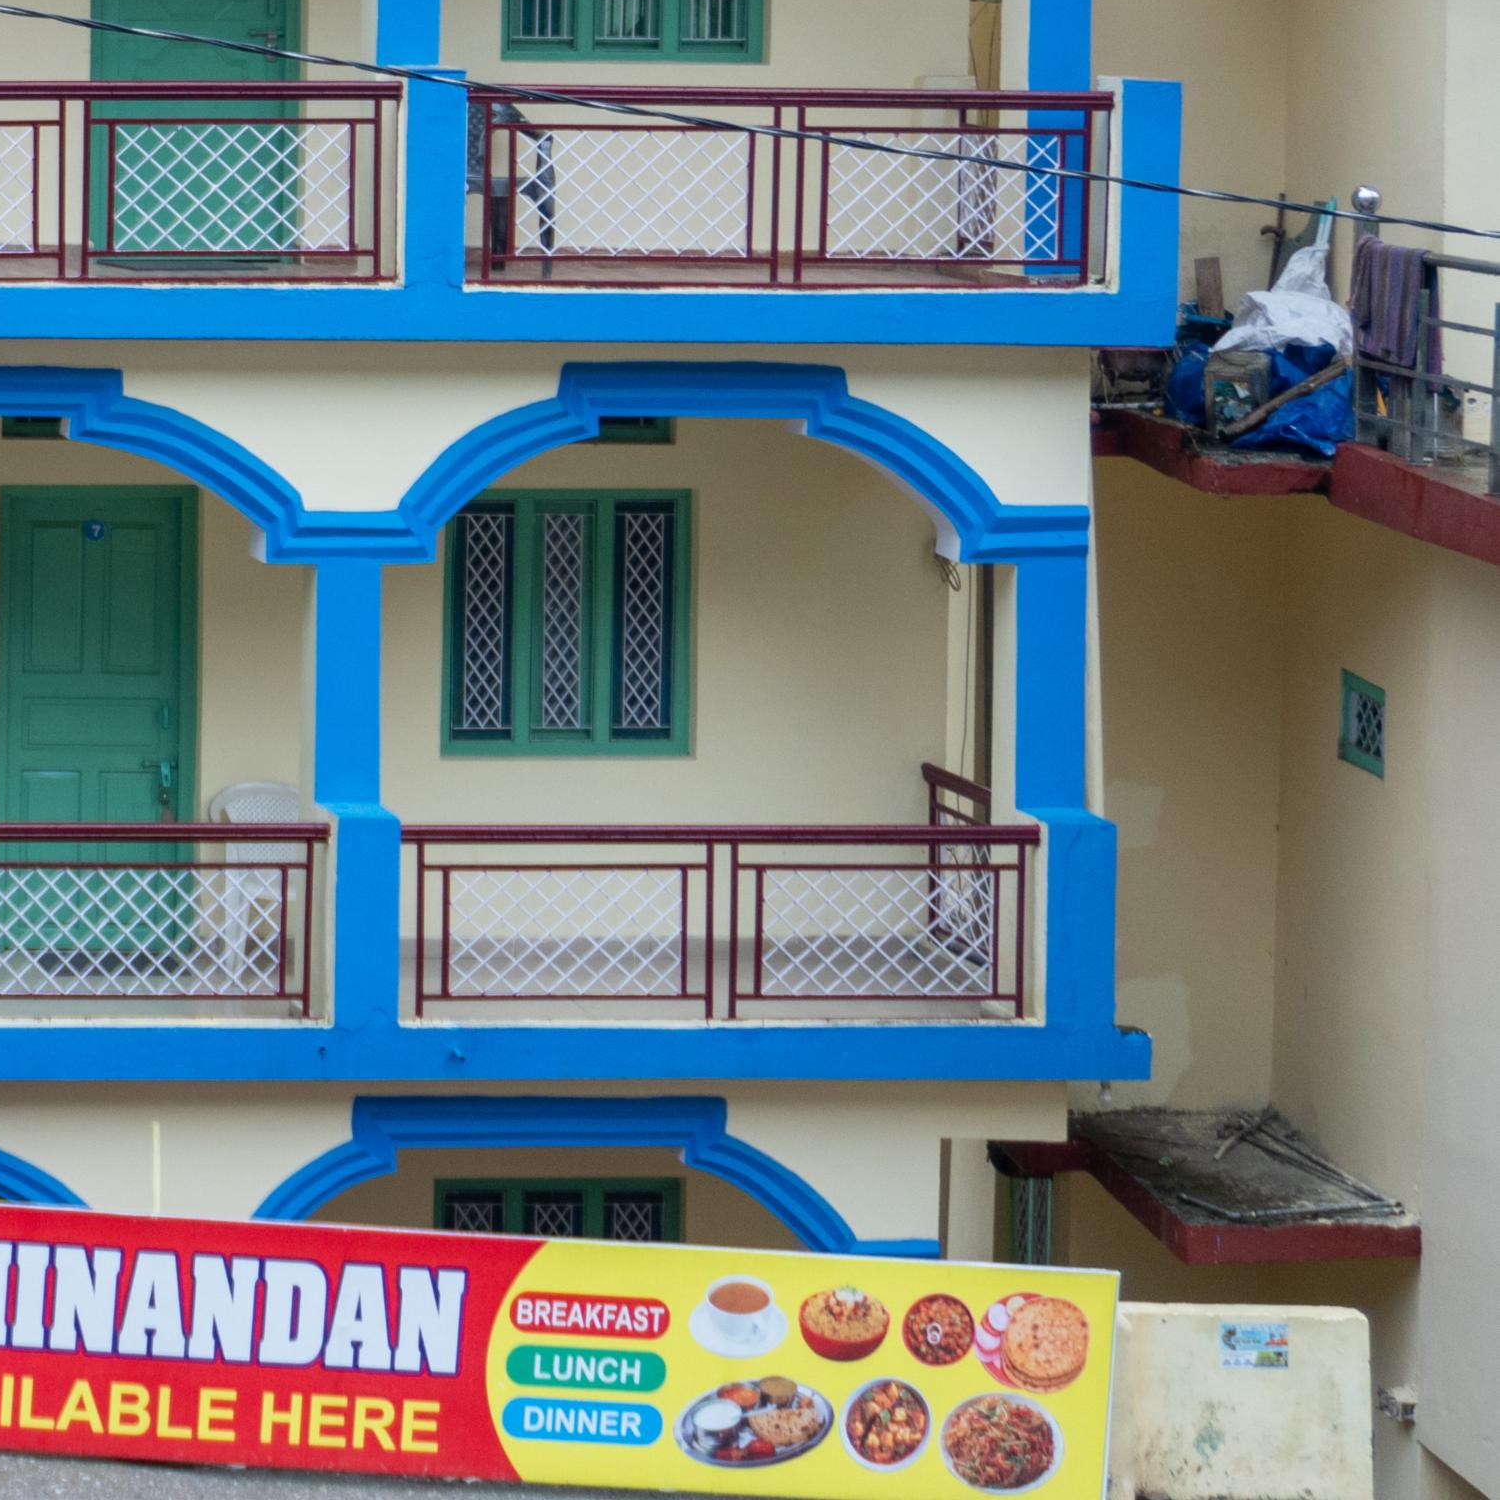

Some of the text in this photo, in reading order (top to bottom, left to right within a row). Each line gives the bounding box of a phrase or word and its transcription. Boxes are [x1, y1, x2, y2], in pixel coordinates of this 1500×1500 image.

[516, 1298, 665, 1333] BREAKFAST
[533, 1352, 642, 1385] LUNCH
[259, 1390, 441, 1454] HERE
[522, 1405, 642, 1438] DINNER
